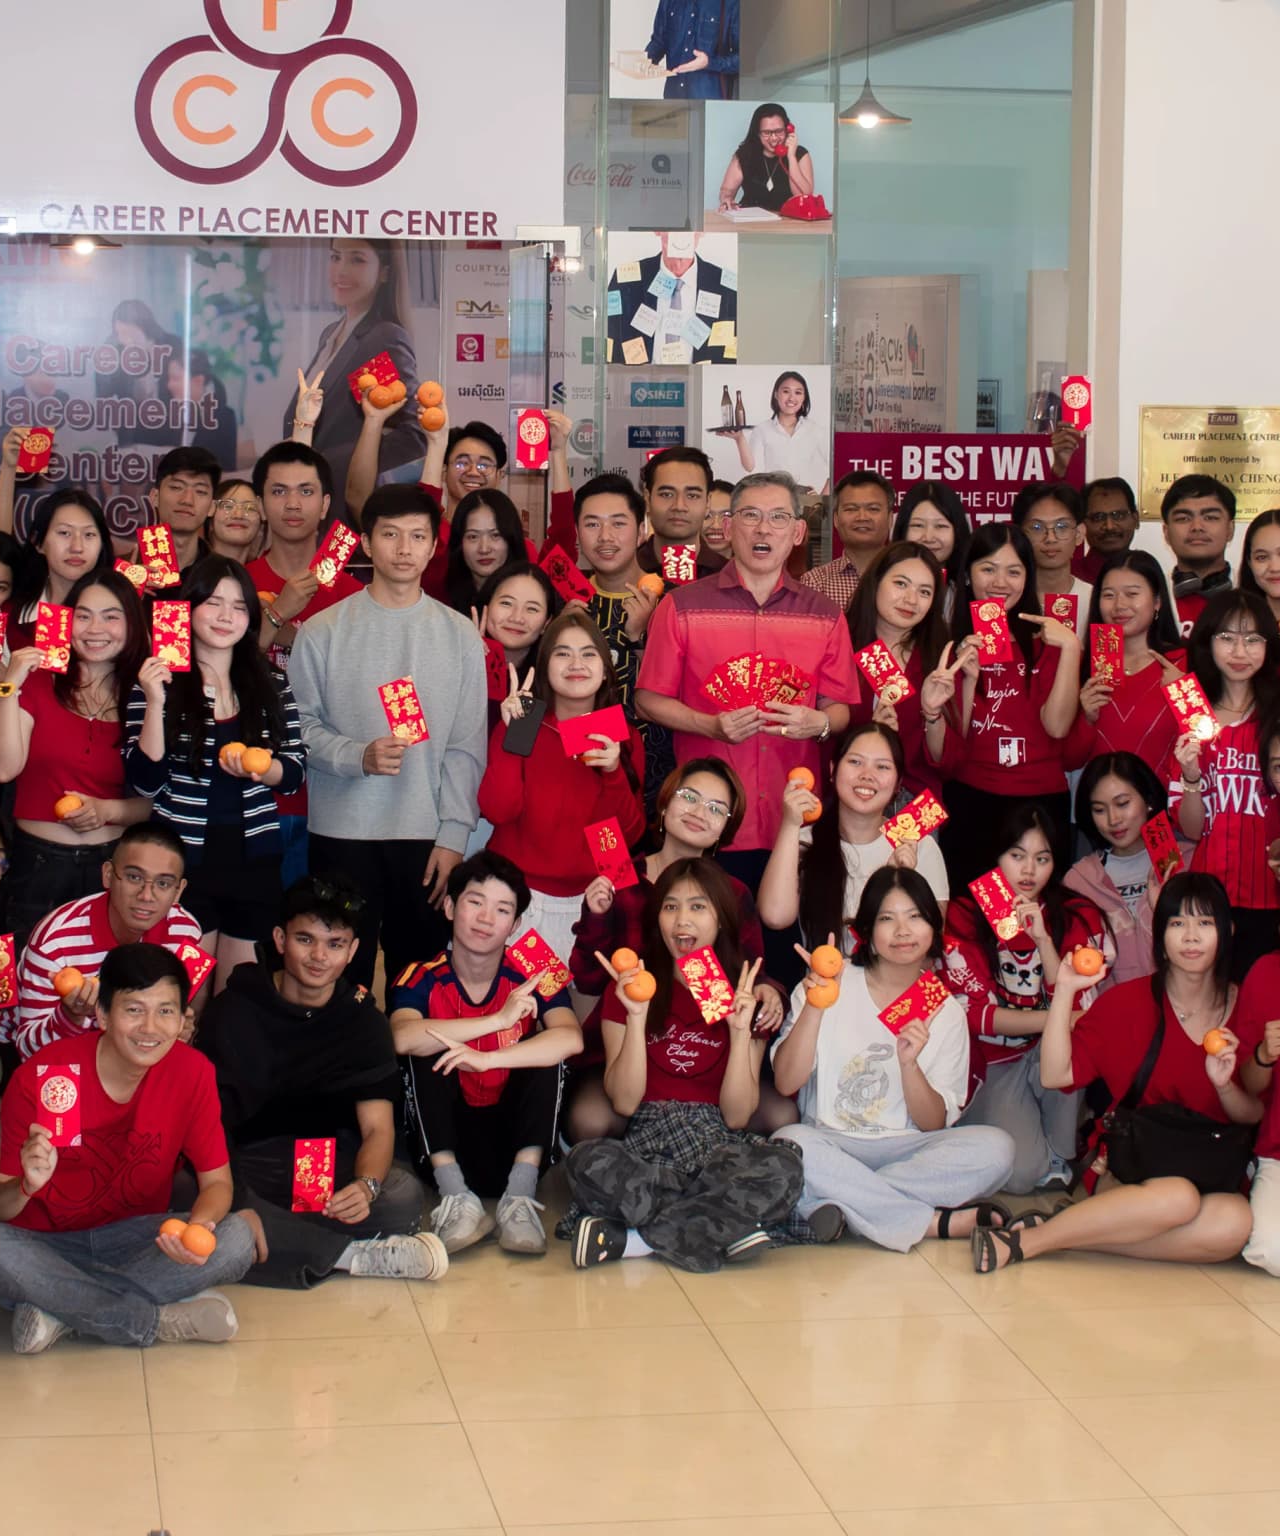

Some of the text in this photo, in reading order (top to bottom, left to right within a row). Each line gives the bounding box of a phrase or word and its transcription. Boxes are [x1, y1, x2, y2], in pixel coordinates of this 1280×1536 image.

[39, 203, 499, 238] CAREER PLACEMENT CENTER
[456, 265, 510, 273] COURTYA
[5, 335, 172, 376] Career
[646, 390, 681, 401] SINET
[655, 429, 681, 439] BANK
[1163, 432, 1280, 441] CAREER PLACEMENT CENTRE
[14, 445, 160, 482] enter
[849, 460, 893, 480] THE
[902, 446, 984, 481] BEST
[1183, 455, 1261, 465] Officially Opened by
[584, 466, 630, 479] Mnulife
[599, 827, 618, 852] 福
